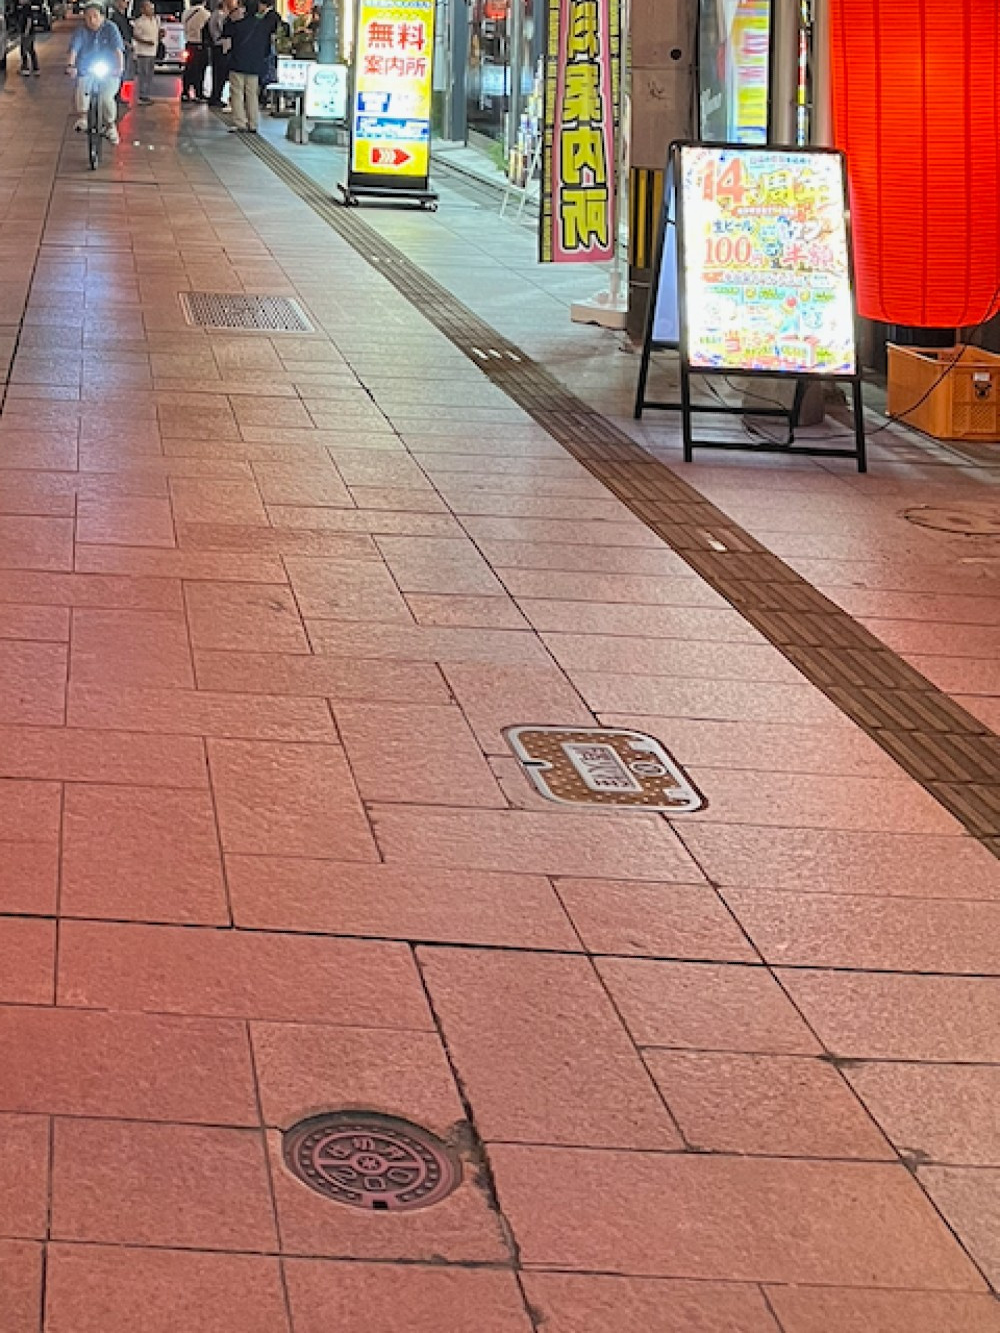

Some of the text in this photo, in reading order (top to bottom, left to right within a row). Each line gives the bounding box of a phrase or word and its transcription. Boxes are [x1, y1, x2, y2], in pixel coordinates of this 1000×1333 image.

[367, 21, 426, 51] 無料
[363, 54, 426, 78] 案内所
